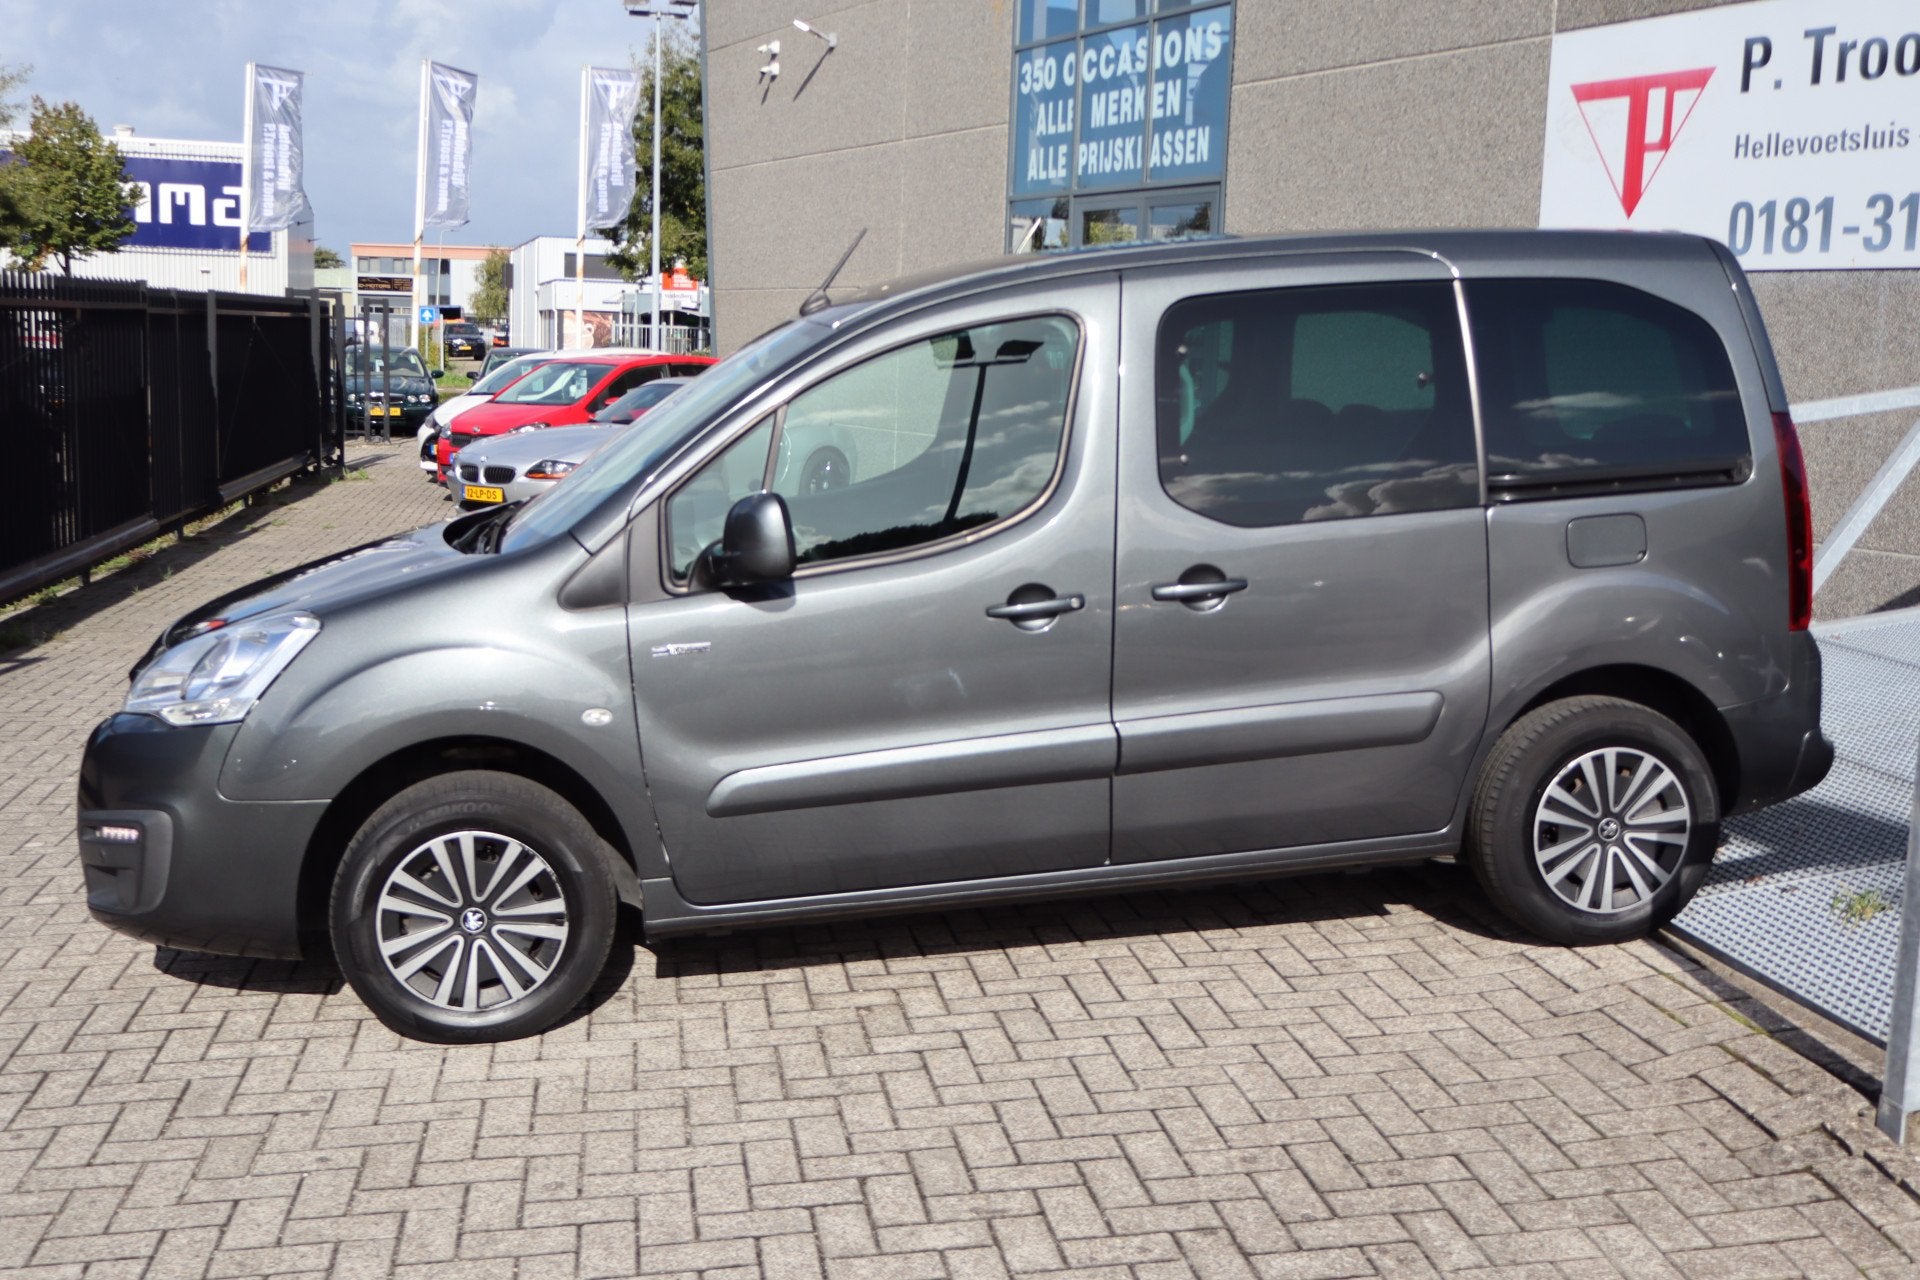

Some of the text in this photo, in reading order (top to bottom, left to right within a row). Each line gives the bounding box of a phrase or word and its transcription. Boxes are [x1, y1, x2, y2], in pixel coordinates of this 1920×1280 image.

[1020, 21, 1222, 95] 350 OCCASIONS
[1740, 35, 1782, 94] P.
[1036, 78, 1182, 136] ALLE MERKEN
[1027, 143, 1068, 181] ALLE
[1733, 122, 1911, 160] Hellevoetsluis
[1727, 191, 1920, 257] 0181-31
[466, 488, 498, 500] 12-LP-DS
